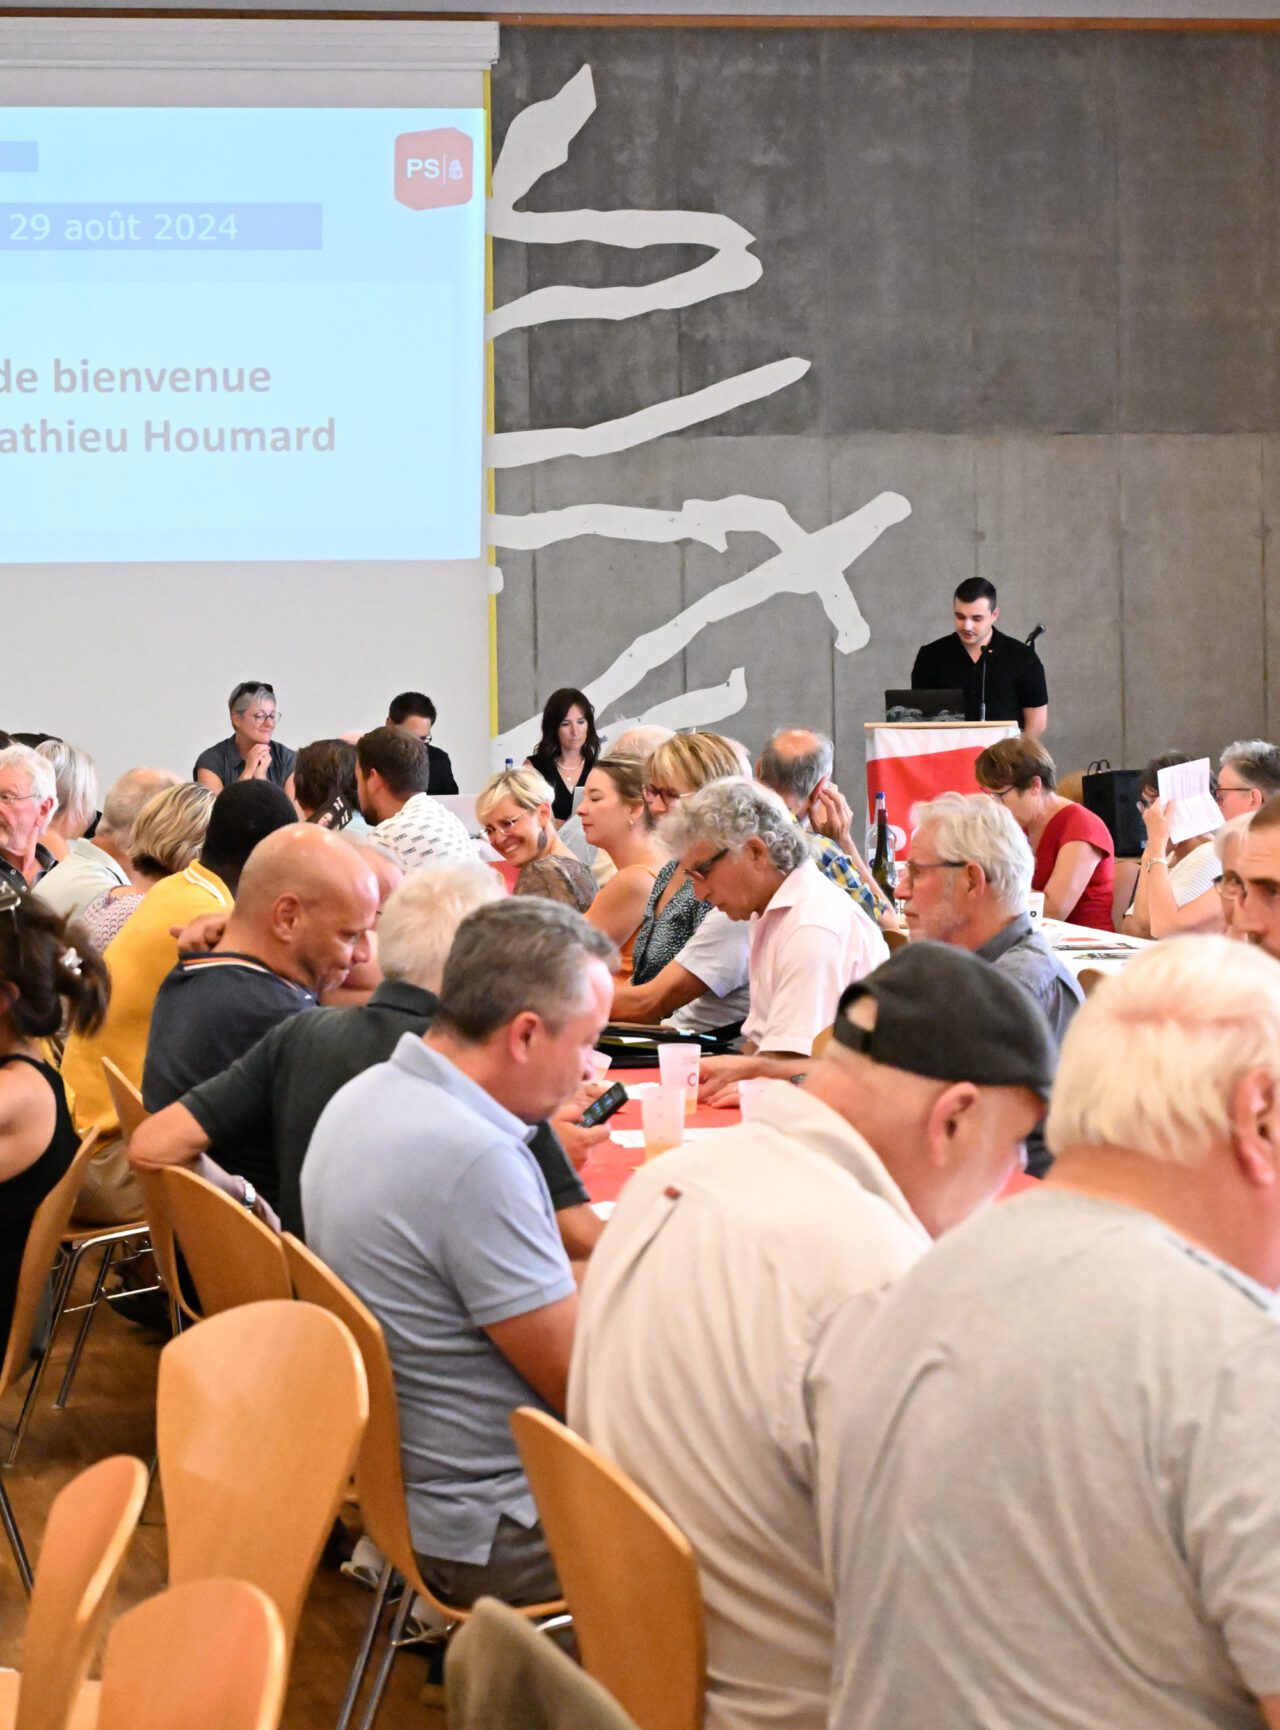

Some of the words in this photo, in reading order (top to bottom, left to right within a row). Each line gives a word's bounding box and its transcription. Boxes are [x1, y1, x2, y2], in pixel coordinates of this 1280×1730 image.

[406, 158, 441, 179] PS
[8, 213, 50, 241] 29
[64, 209, 141, 241] août
[153, 212, 239, 241] 2024
[53, 357, 273, 394] bienvenue
[144, 415, 337, 453] Houmard
